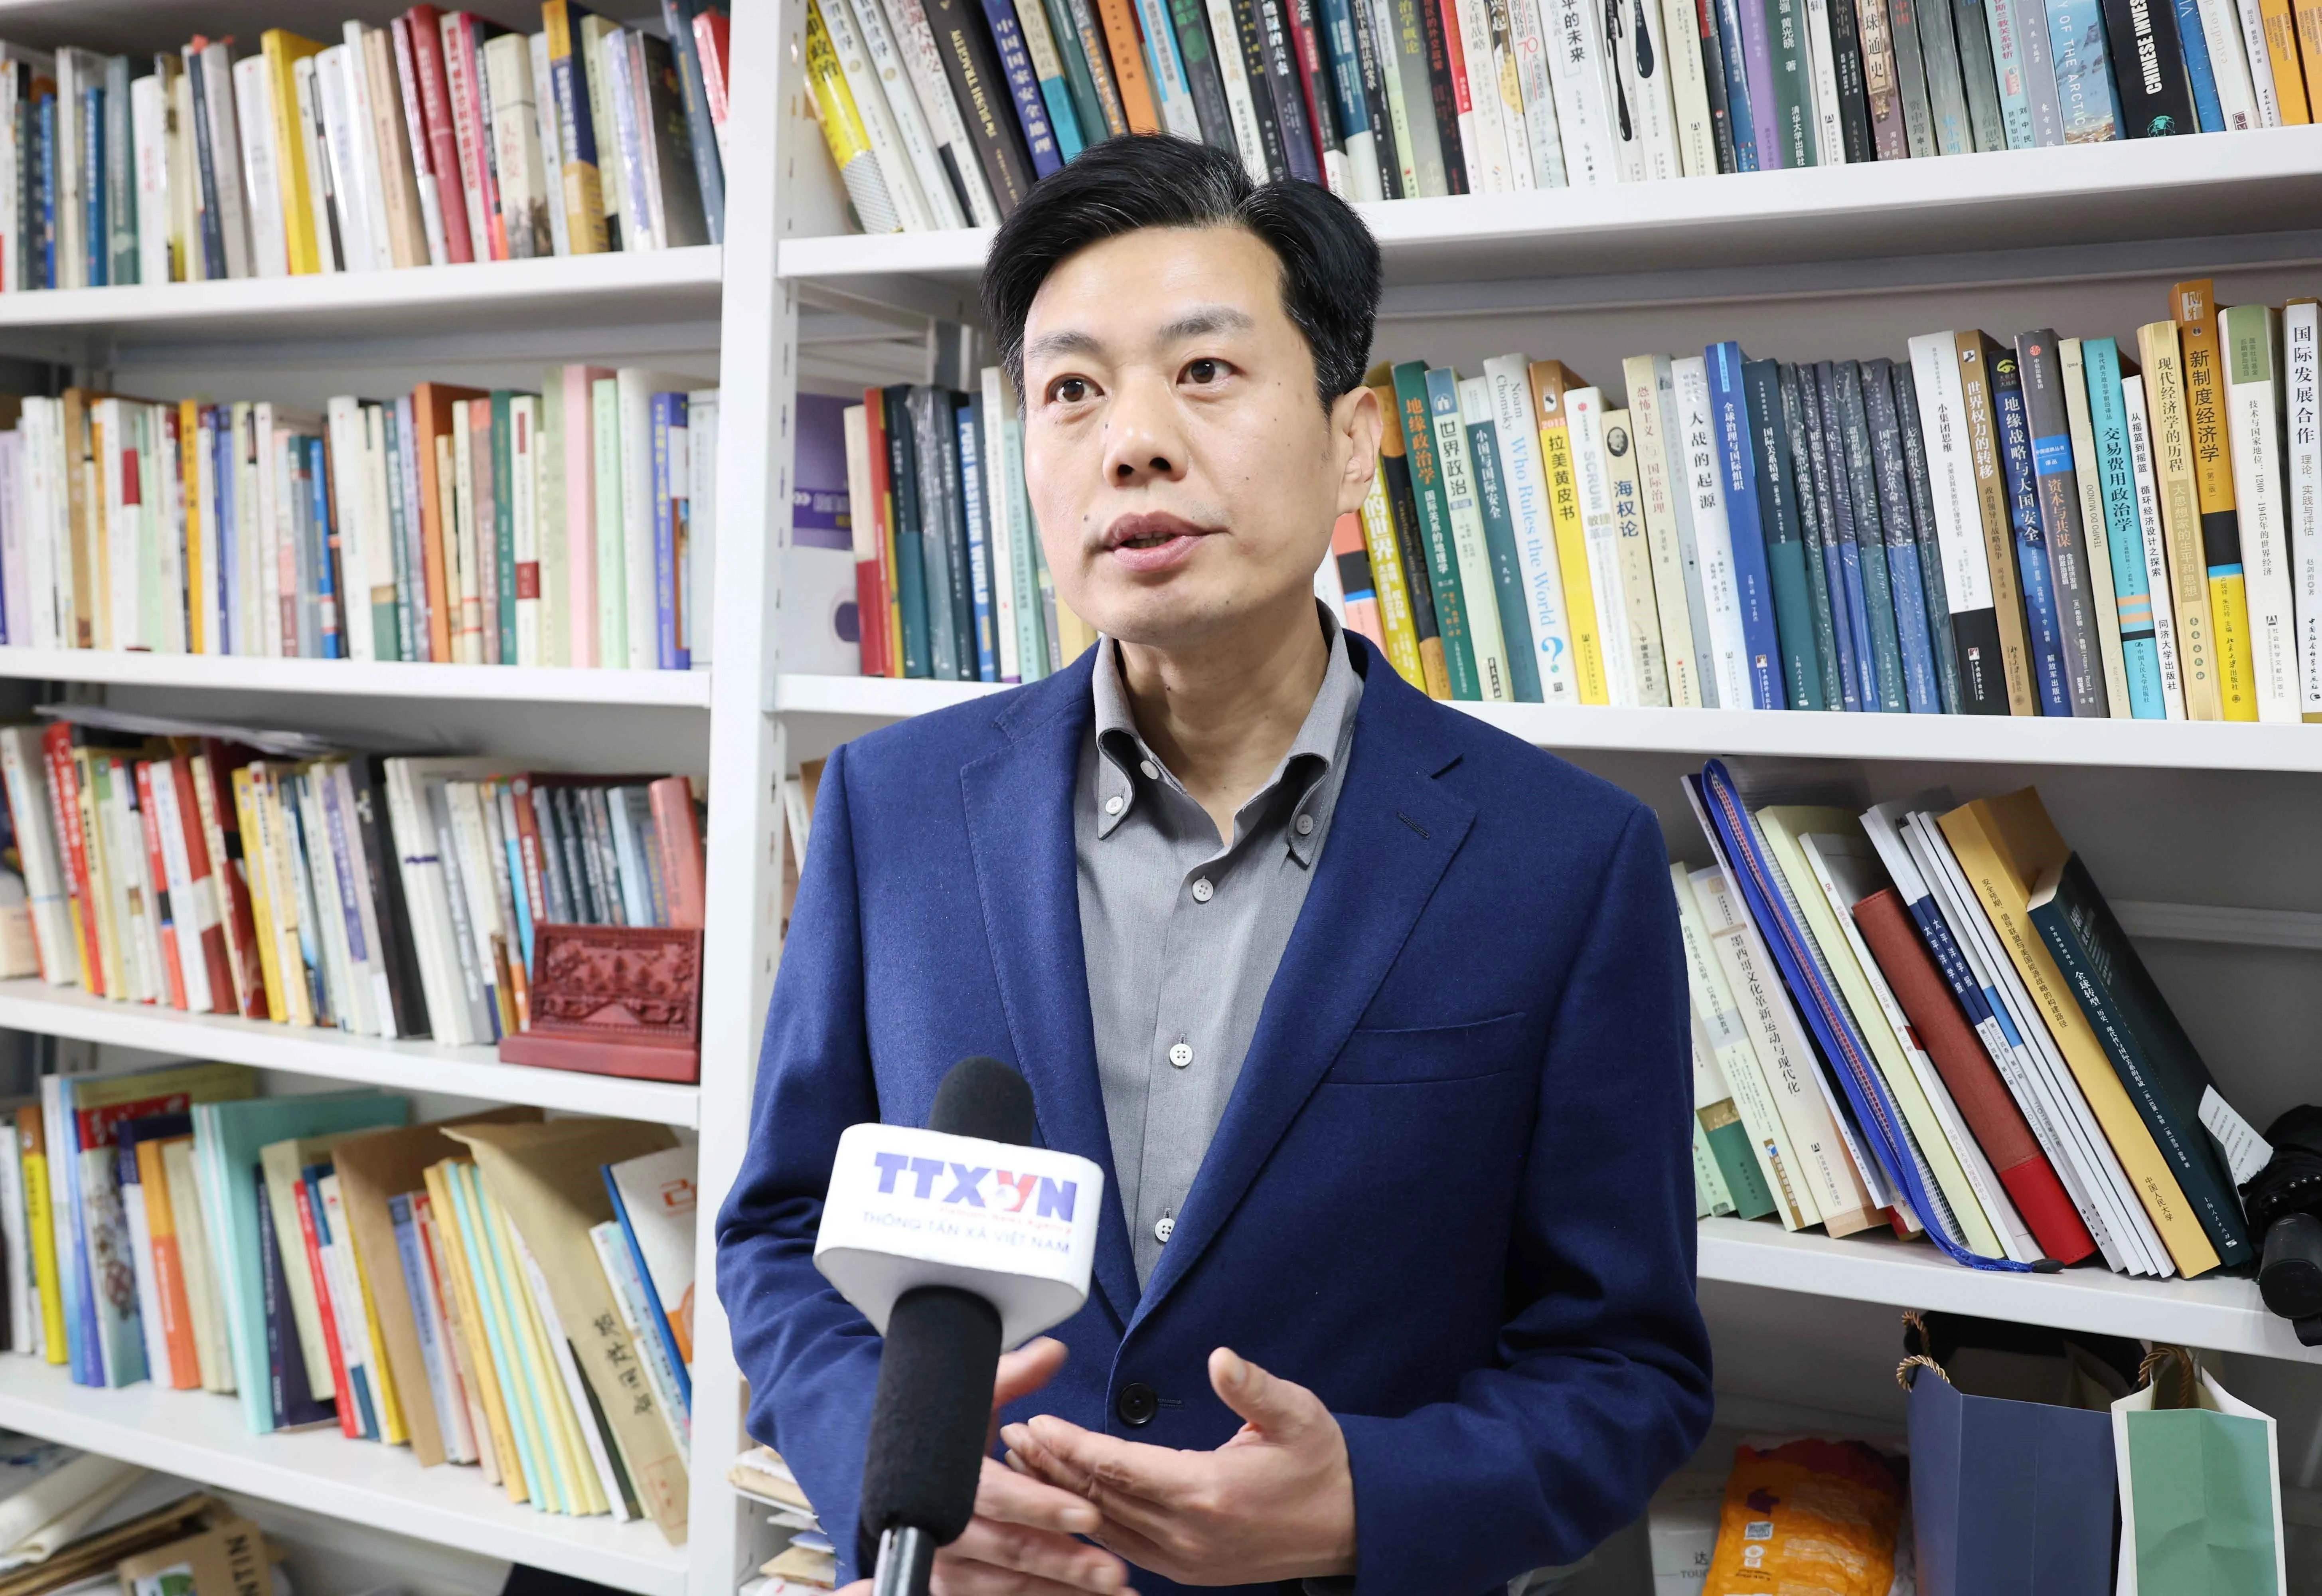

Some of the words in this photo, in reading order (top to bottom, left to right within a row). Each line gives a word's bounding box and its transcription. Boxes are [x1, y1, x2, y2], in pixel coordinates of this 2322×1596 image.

[2059, 16, 2072, 32] OF
[1786, 60, 1796, 72] 著
[2063, 38, 2077, 67] THE
[2137, 35, 2162, 95] CHINESE
[2019, 107, 2032, 143] 刘中民
[2068, 74, 2086, 126] ARCTIC
[1792, 106, 1805, 166] 清华大学出版社
[2034, 358, 2044, 389] 中信出版集团
[2249, 337, 2258, 376] 国家社科基金
[1496, 375, 1513, 431] Chomsky
[1510, 383, 1523, 418] Noam
[2097, 352, 2113, 420] 当代西方政治学前沿译丛
[2190, 349, 2219, 462] 新制度经济学
[2294, 325, 2315, 445] 国际发展合作
[1541, 418, 1566, 430] 2015
[1724, 401, 1745, 491] 全球治理与国际组织
[1938, 403, 1954, 453] 小集团思维
[1440, 420, 1467, 496] 世界政治
[1476, 429, 1501, 519] 小国与国际安全
[1510, 437, 1529, 480] Who
[1549, 435, 1576, 521] 拉美黄皮书
[1584, 451, 1603, 510] SCRUM
[1763, 427, 1779, 482] 国际关系精要
[1967, 380, 1994, 480] 世界权力的转移
[1985, 486, 2002, 560] 政治领导与战略竞争
[2004, 396, 2039, 541] 地缘战略与大国安全
[2103, 427, 2133, 532] 交易费用政治学
[2157, 357, 2184, 473] 现代经济学的历程
[2173, 484, 2198, 597] 大思想家的生平和思想
[1406, 397, 1435, 485] 地缘政治学
[1425, 490, 1449, 574] 国际关系的地理学
[1518, 484, 1538, 535] Rules
[1613, 480, 1639, 537] 海权论
[2048, 478, 2071, 547] 资本与共谋
[2086, 484, 2097, 511] MUNDO
[2131, 413, 2148, 474] 从摇篮到摇篮
[2140, 485, 2162, 577] 循环经济设计之探索
[2301, 454, 2315, 537] 理论、实践与评估
[2091, 512, 2098, 523] DO
[2093, 524, 2102, 549] TEMPO
[1526, 539, 1544, 568] the
[2065, 553, 2077, 590] 全球经济发展
[1534, 571, 1556, 626] World
[2225, 621, 2233, 633] 主编
[2047, 654, 2061, 703] 解放军出版社
[2137, 649, 2150, 703] 中国人民大学出版社
[2158, 619, 2177, 691] 同济大学出版社
[2226, 637, 2239, 691] 北京大学出版社
[2272, 628, 2284, 699] 社会科学文献出版社
[1836, 905, 1850, 928] 中国外交
[1923, 926, 1964, 994] 太平洋学报
[1933, 918, 1973, 988] 太平洋学报
[1730, 934, 1801, 1095] 墨西哥文化革新运动与现代化
[2075, 970, 2102, 1007] 全球转型
[2144, 1175, 2173, 1222] 中国人民大学
[863, 1210, 921, 1229] THÔNG
[1031, 1236, 1070, 1254] NAM
